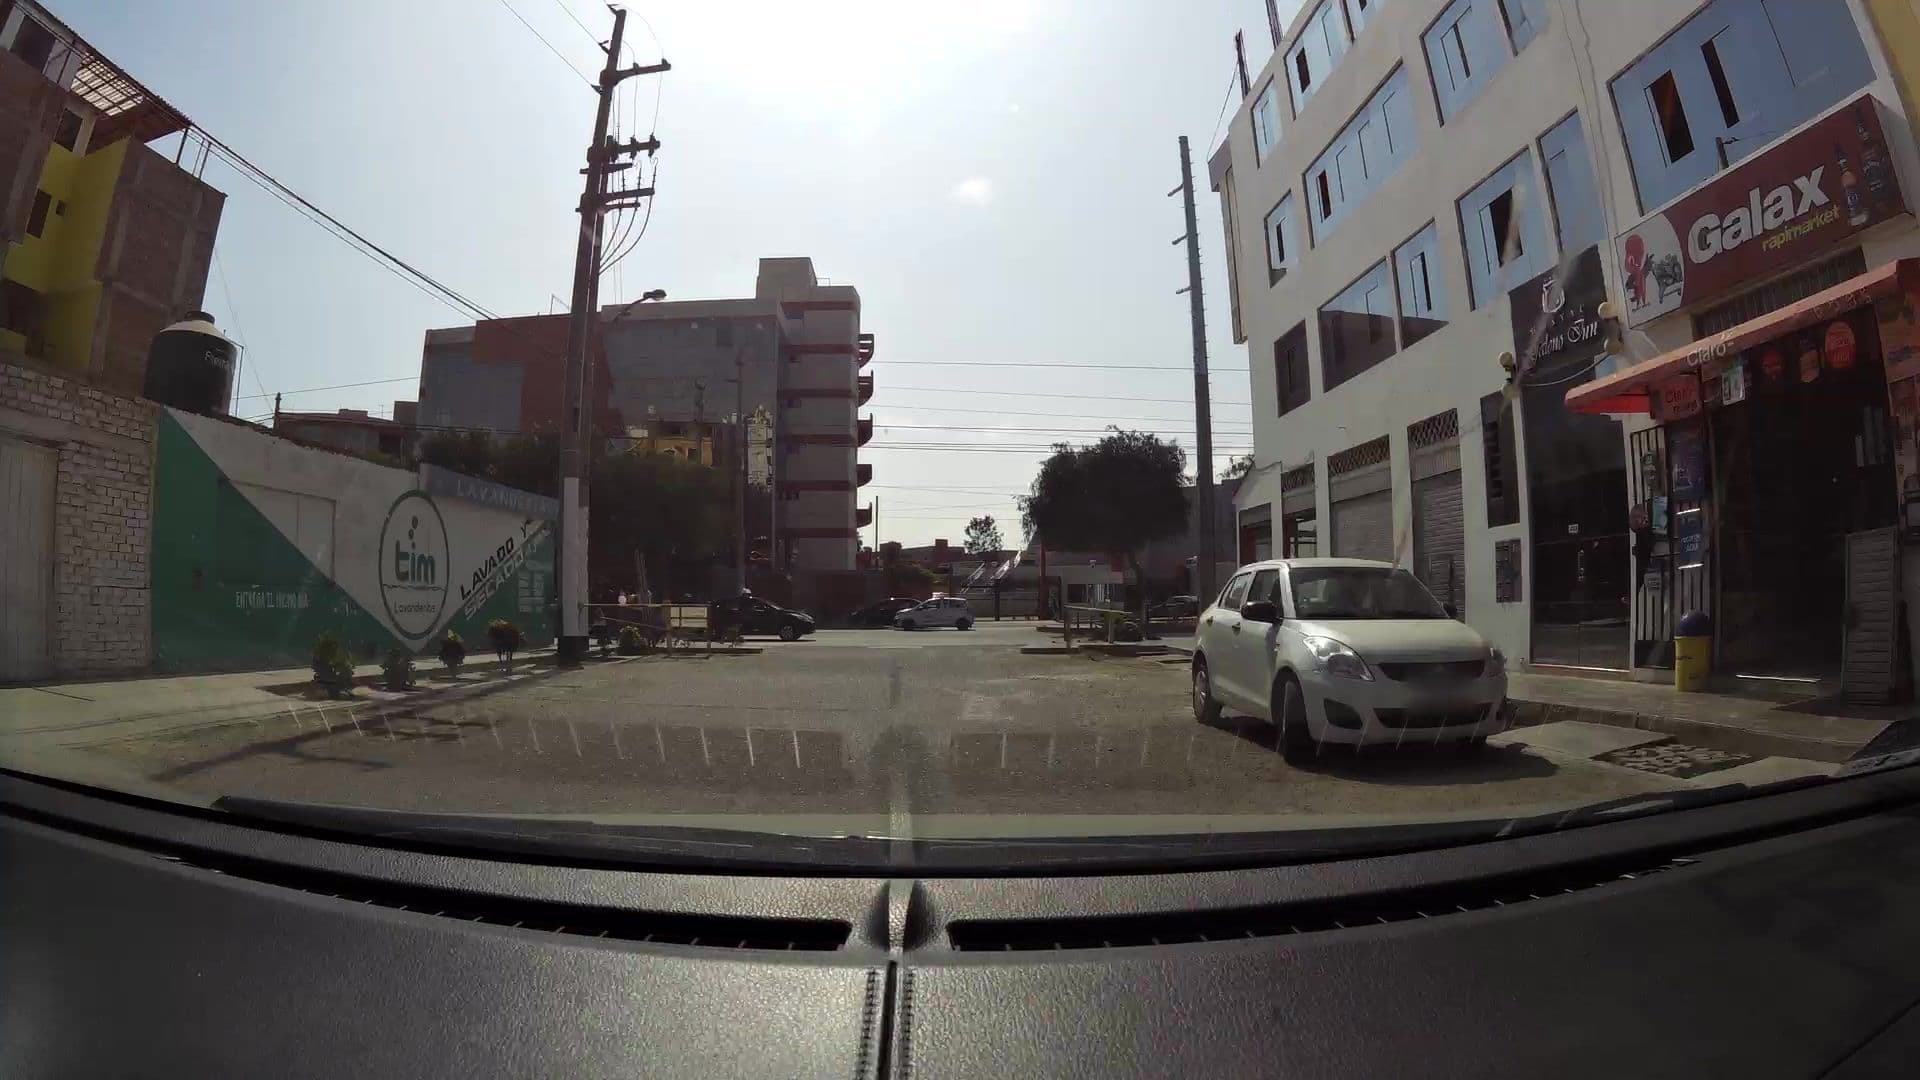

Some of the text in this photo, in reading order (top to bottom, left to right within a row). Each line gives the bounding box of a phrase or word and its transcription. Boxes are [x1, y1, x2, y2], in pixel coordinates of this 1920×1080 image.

[1687, 165, 1831, 264] Galax
[1761, 203, 1841, 252] rapimarket
[1686, 342, 1728, 367] Claro
[395, 540, 435, 583] tim
[460, 537, 515, 600] LAVADO
